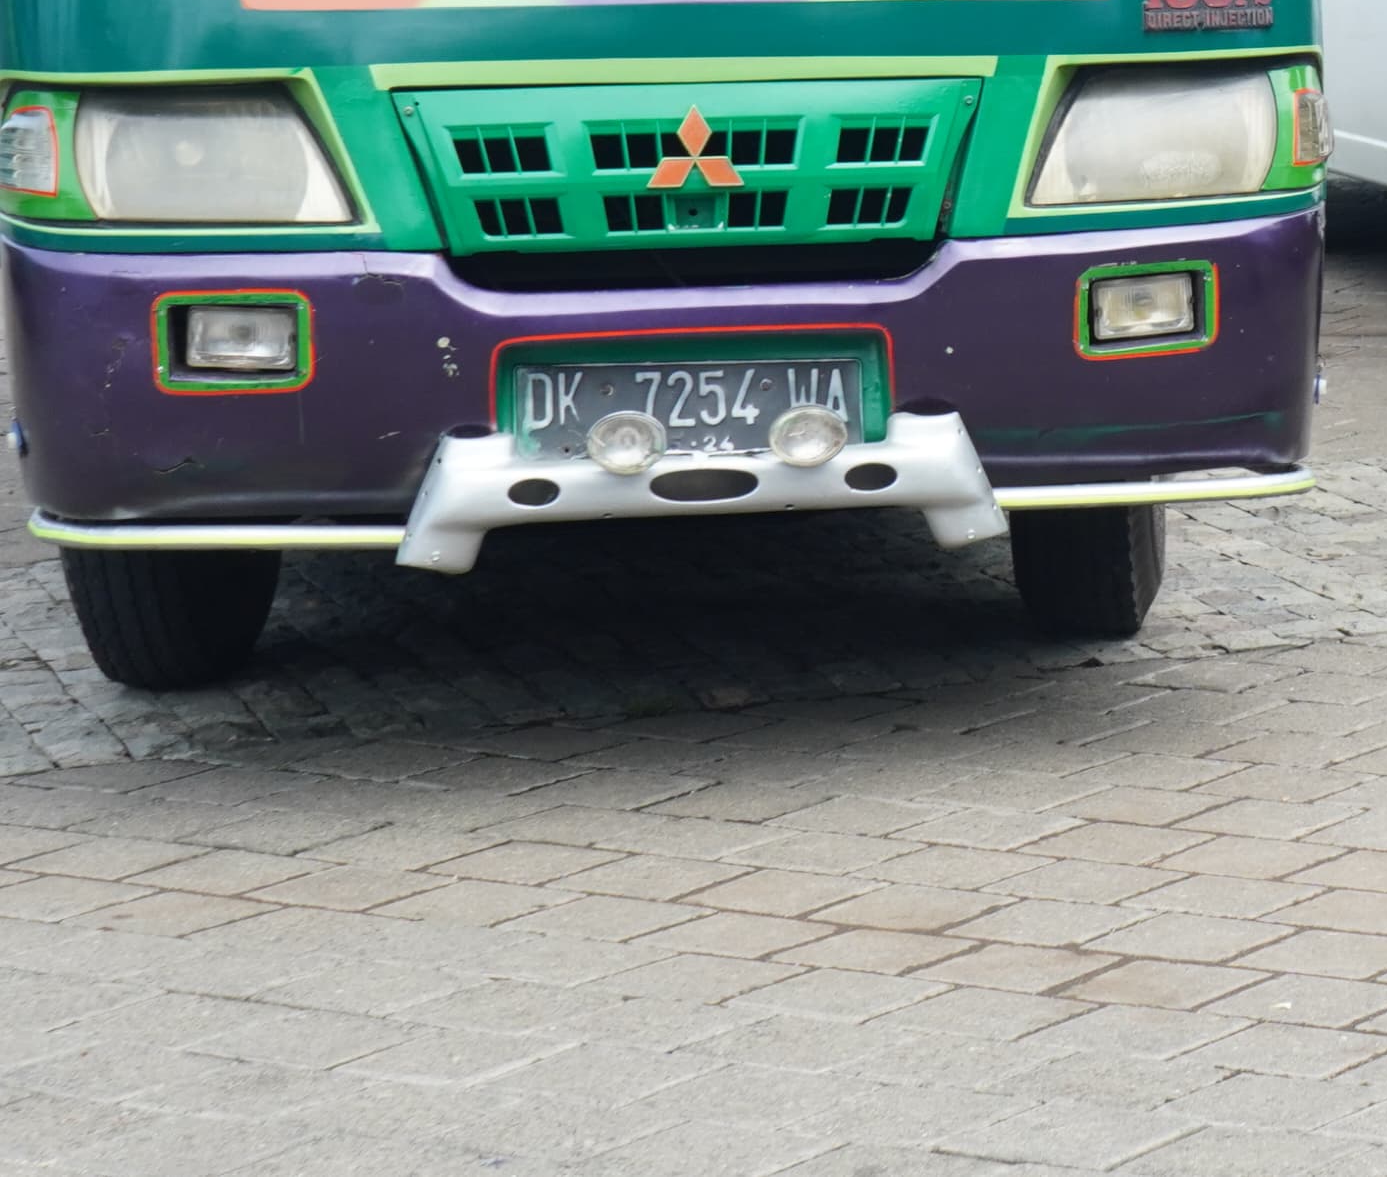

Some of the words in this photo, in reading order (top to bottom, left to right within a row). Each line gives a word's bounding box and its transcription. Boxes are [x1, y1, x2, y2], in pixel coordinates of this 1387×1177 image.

[1145, 11, 1200, 30] DIRECT
[1204, 7, 1274, 28] INJECTION
[525, 370, 584, 431] DK
[633, 368, 761, 428] 7254
[786, 367, 850, 424] WA
